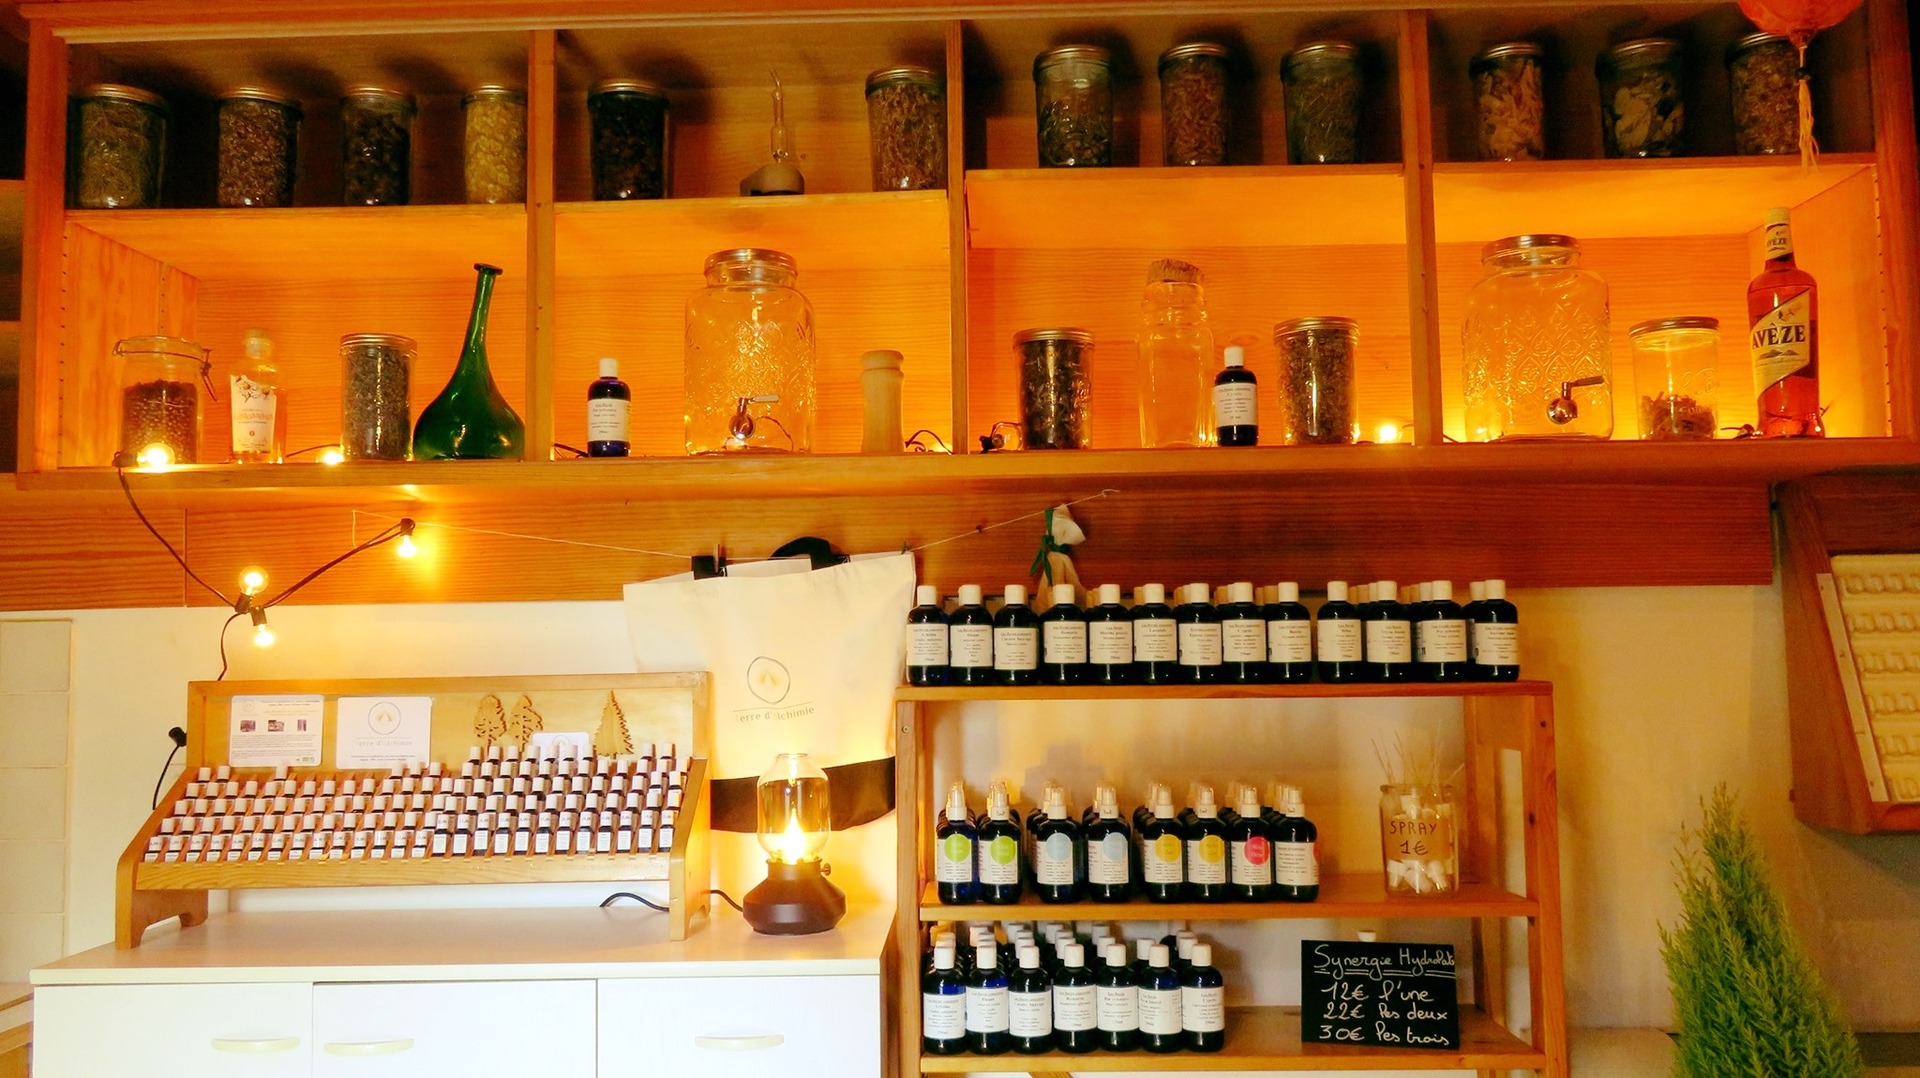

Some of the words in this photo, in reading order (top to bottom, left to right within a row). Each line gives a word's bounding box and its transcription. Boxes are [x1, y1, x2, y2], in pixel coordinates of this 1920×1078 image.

[1753, 323, 1805, 349] AVÈZE
[734, 711, 761, 723] erre
[1389, 820, 1437, 835] SPRAY
[1400, 840, 1428, 855] 1€
[1314, 944, 1392, 980] Synergie
[1321, 982, 1369, 1001] 12€
[1379, 980, 1434, 1002] l'une
[1323, 1001, 1365, 1020] 22€
[1378, 1003, 1400, 1019] les
[1407, 1002, 1447, 1020] deux
[1319, 1024, 1365, 1041] 30€
[1375, 1020, 1400, 1043] les
[1406, 1026, 1449, 1045] trois
